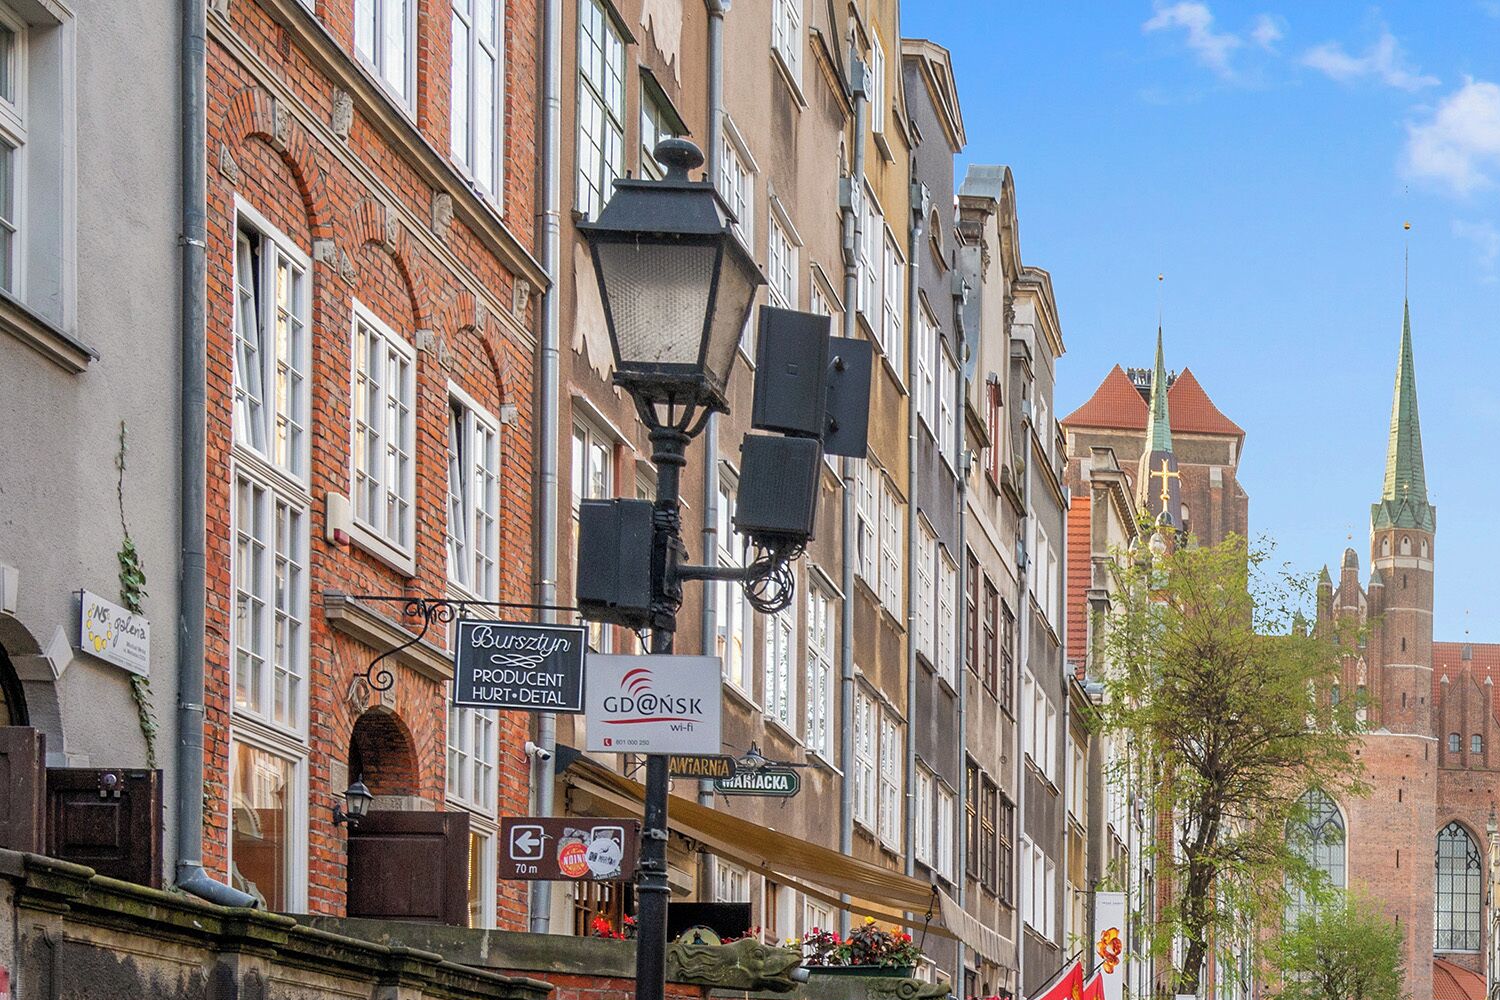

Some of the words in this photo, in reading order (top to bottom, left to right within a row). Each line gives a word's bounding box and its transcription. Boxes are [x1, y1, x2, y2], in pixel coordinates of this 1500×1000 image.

[93, 604, 110, 624] NS
[471, 625, 572, 657] Bursztyn
[473, 668, 565, 688] PRODUCENT
[670, 723, 694, 732] wi-fi
[515, 863, 527, 874] 70
[528, 865, 538, 874] m
